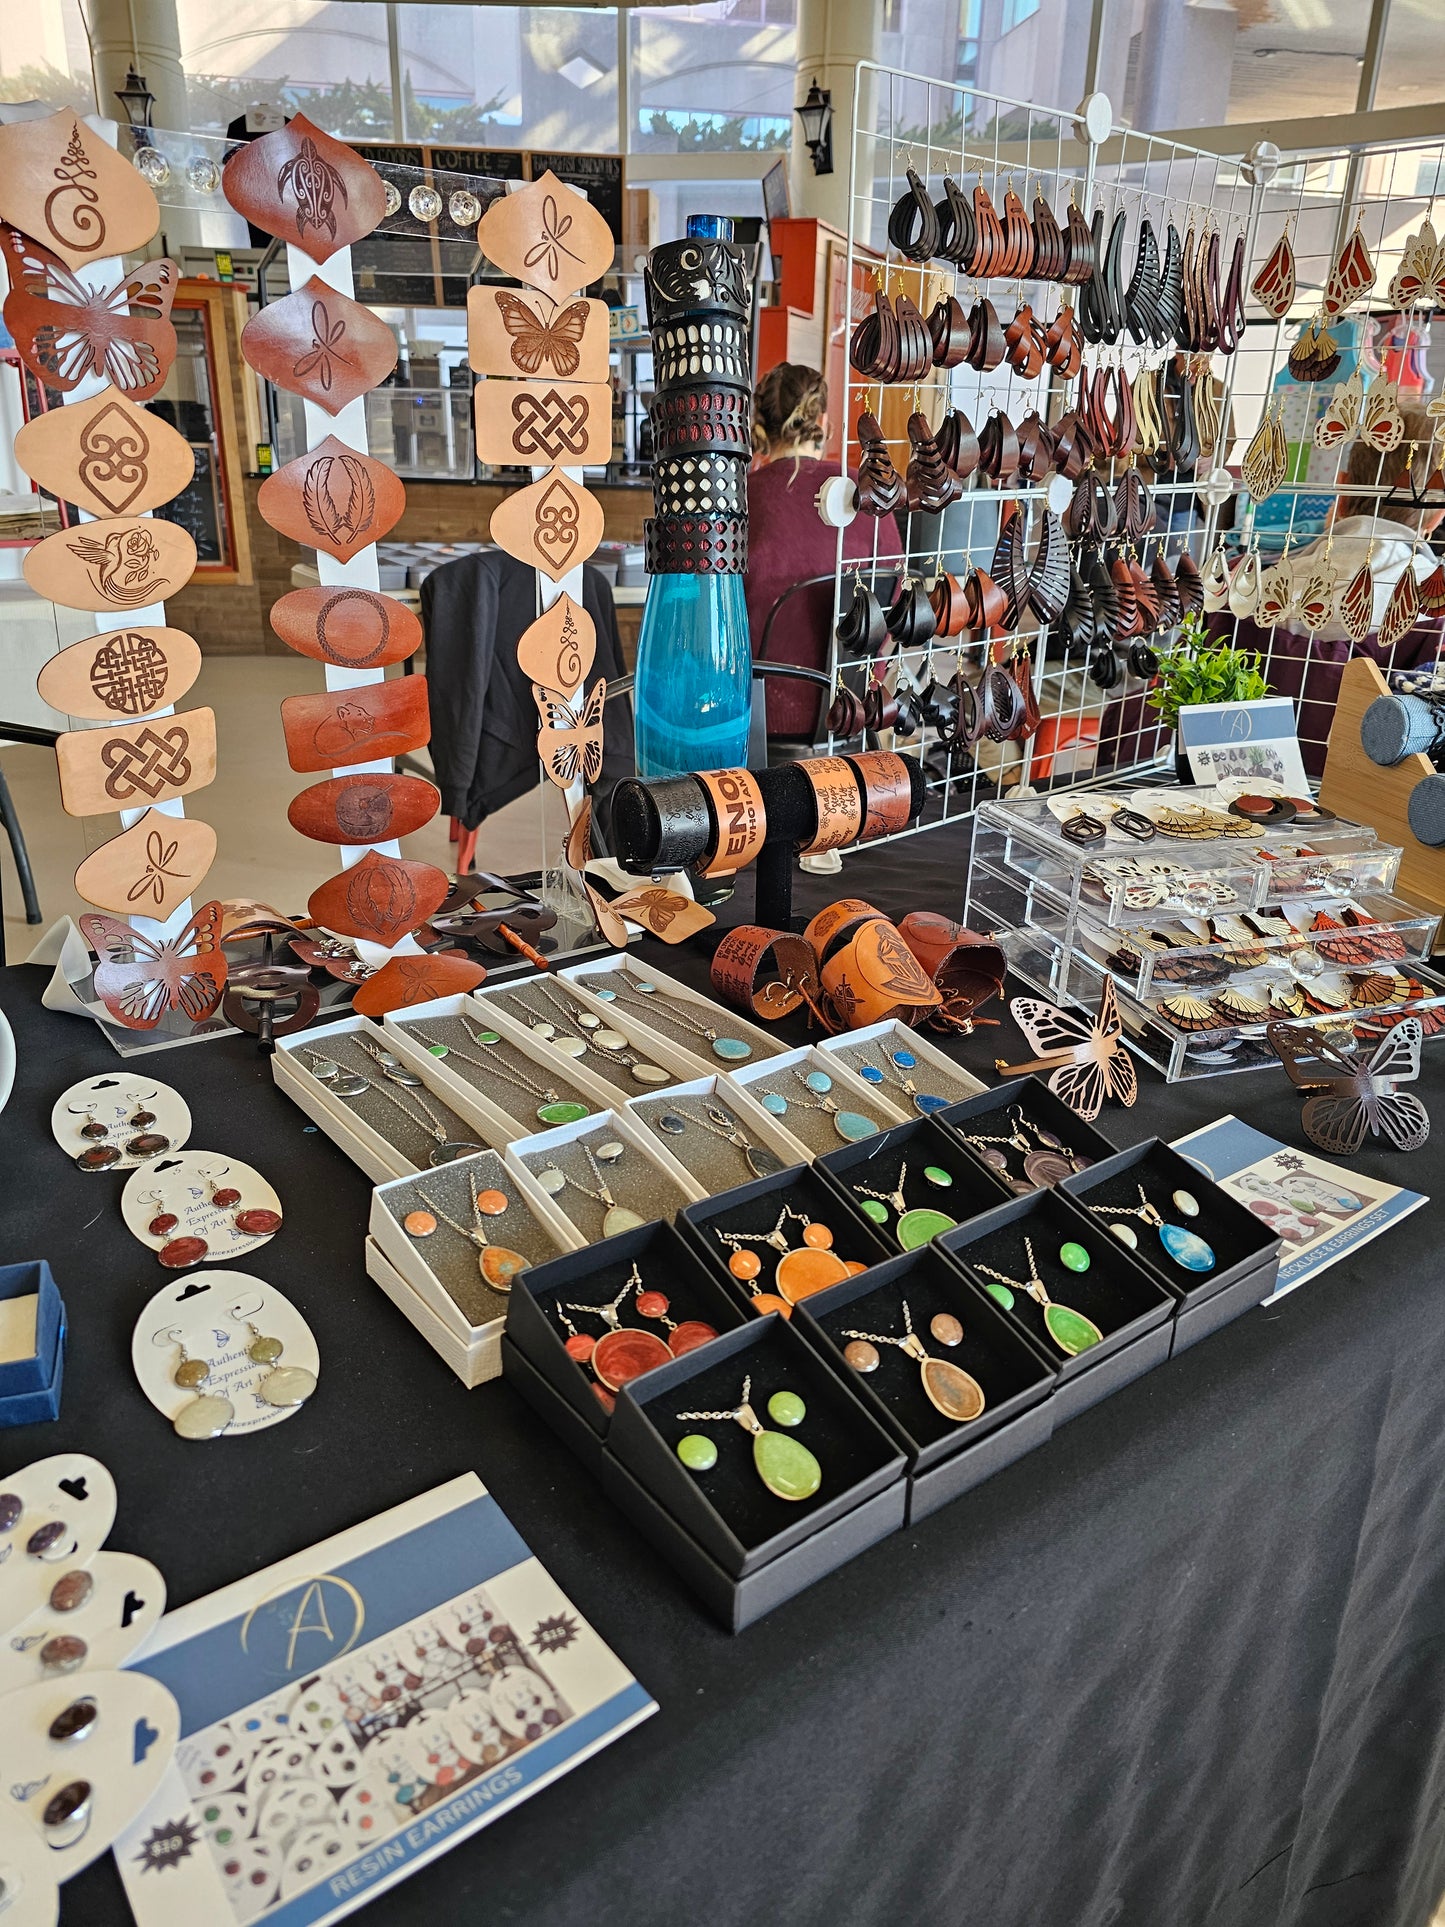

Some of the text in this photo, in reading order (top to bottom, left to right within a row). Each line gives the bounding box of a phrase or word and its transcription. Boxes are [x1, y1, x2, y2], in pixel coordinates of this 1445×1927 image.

[435, 151, 492, 170] COFFEE
[747, 807, 757, 845] WHO
[1277, 1207, 1390, 1280] NECKLACE & EARRINGS SET
[207, 1344, 251, 1368] Authenti
[233, 1379, 254, 1392] Art
[327, 1764, 523, 1899] RESIN EARRINGS
